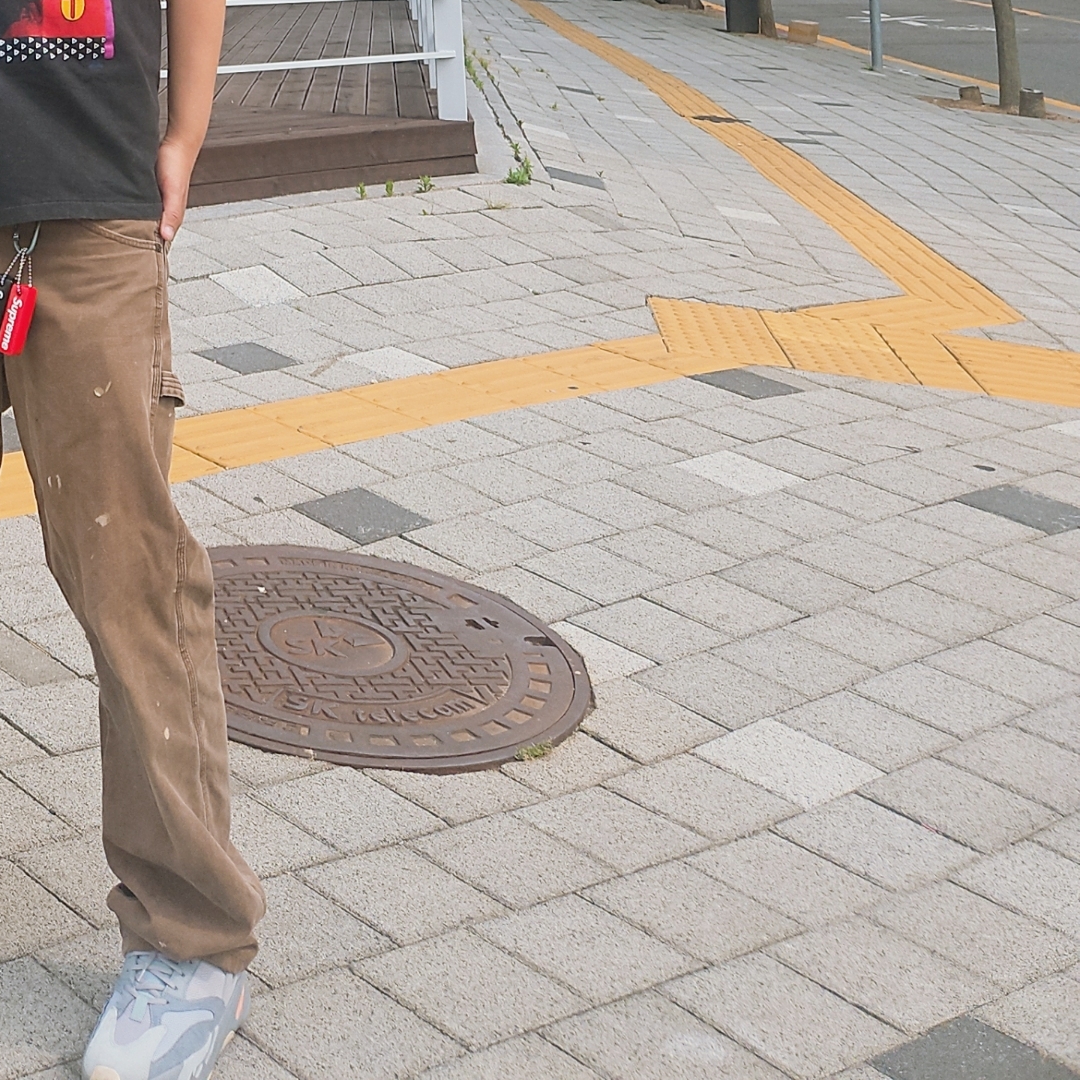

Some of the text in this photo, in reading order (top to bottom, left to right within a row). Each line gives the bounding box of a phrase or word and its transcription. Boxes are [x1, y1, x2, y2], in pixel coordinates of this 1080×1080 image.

[1, 296, 23, 351] Supreme
[284, 637, 348, 659] SK
[282, 693, 477, 724] SK telecom
